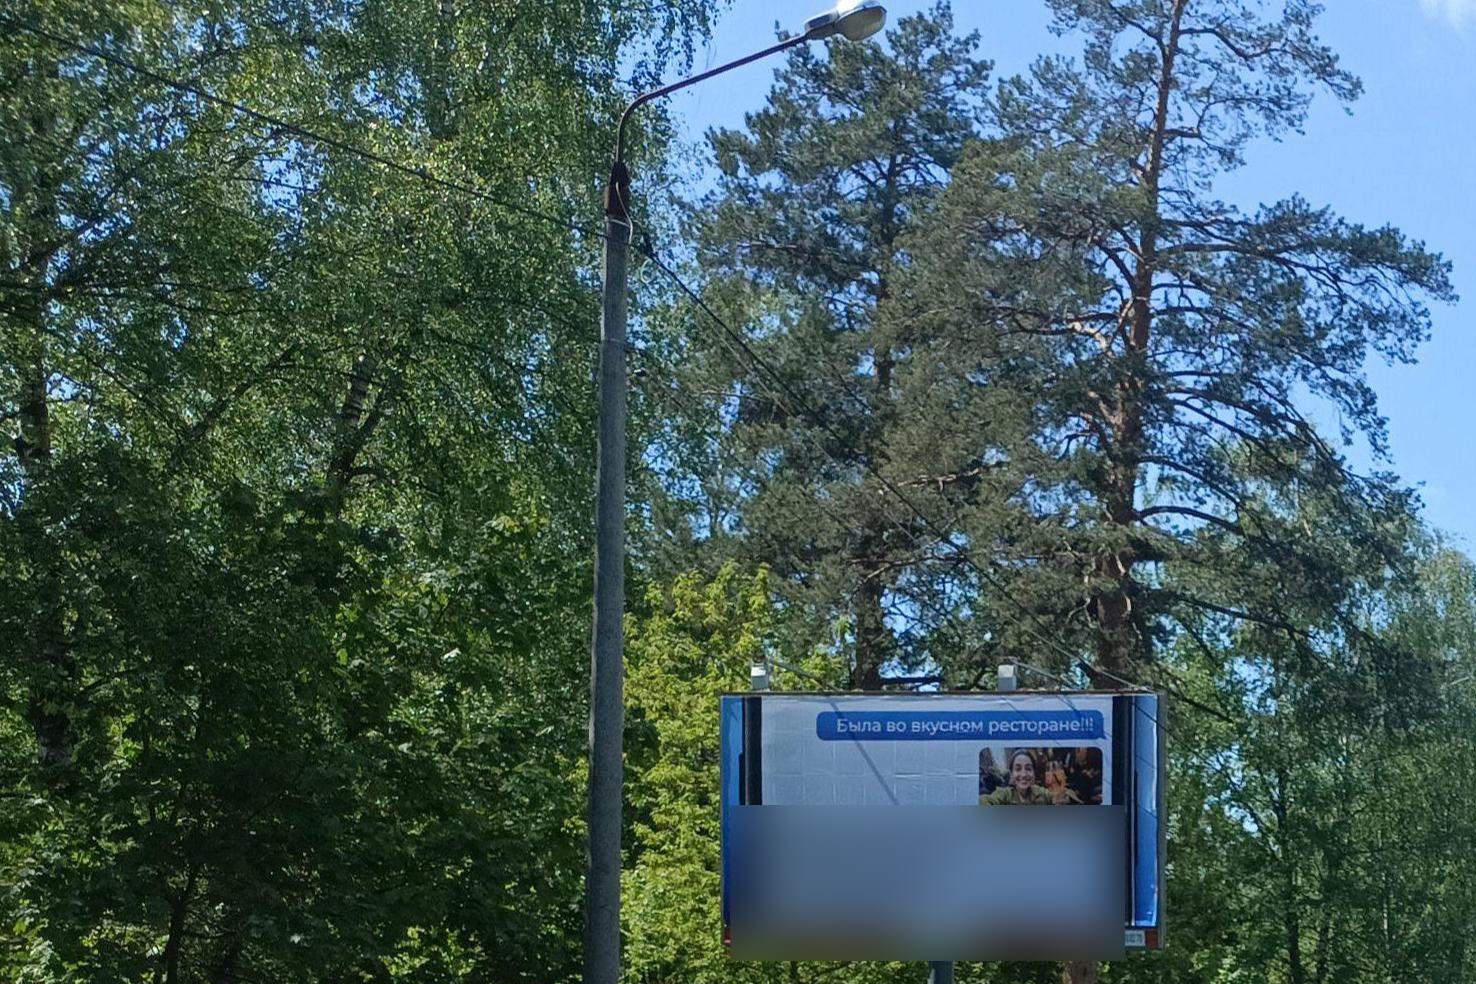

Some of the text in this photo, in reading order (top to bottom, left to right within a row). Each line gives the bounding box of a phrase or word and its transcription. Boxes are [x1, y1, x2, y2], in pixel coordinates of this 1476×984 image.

[837, 717, 1094, 736] Была во вкусном ресторане!!!
